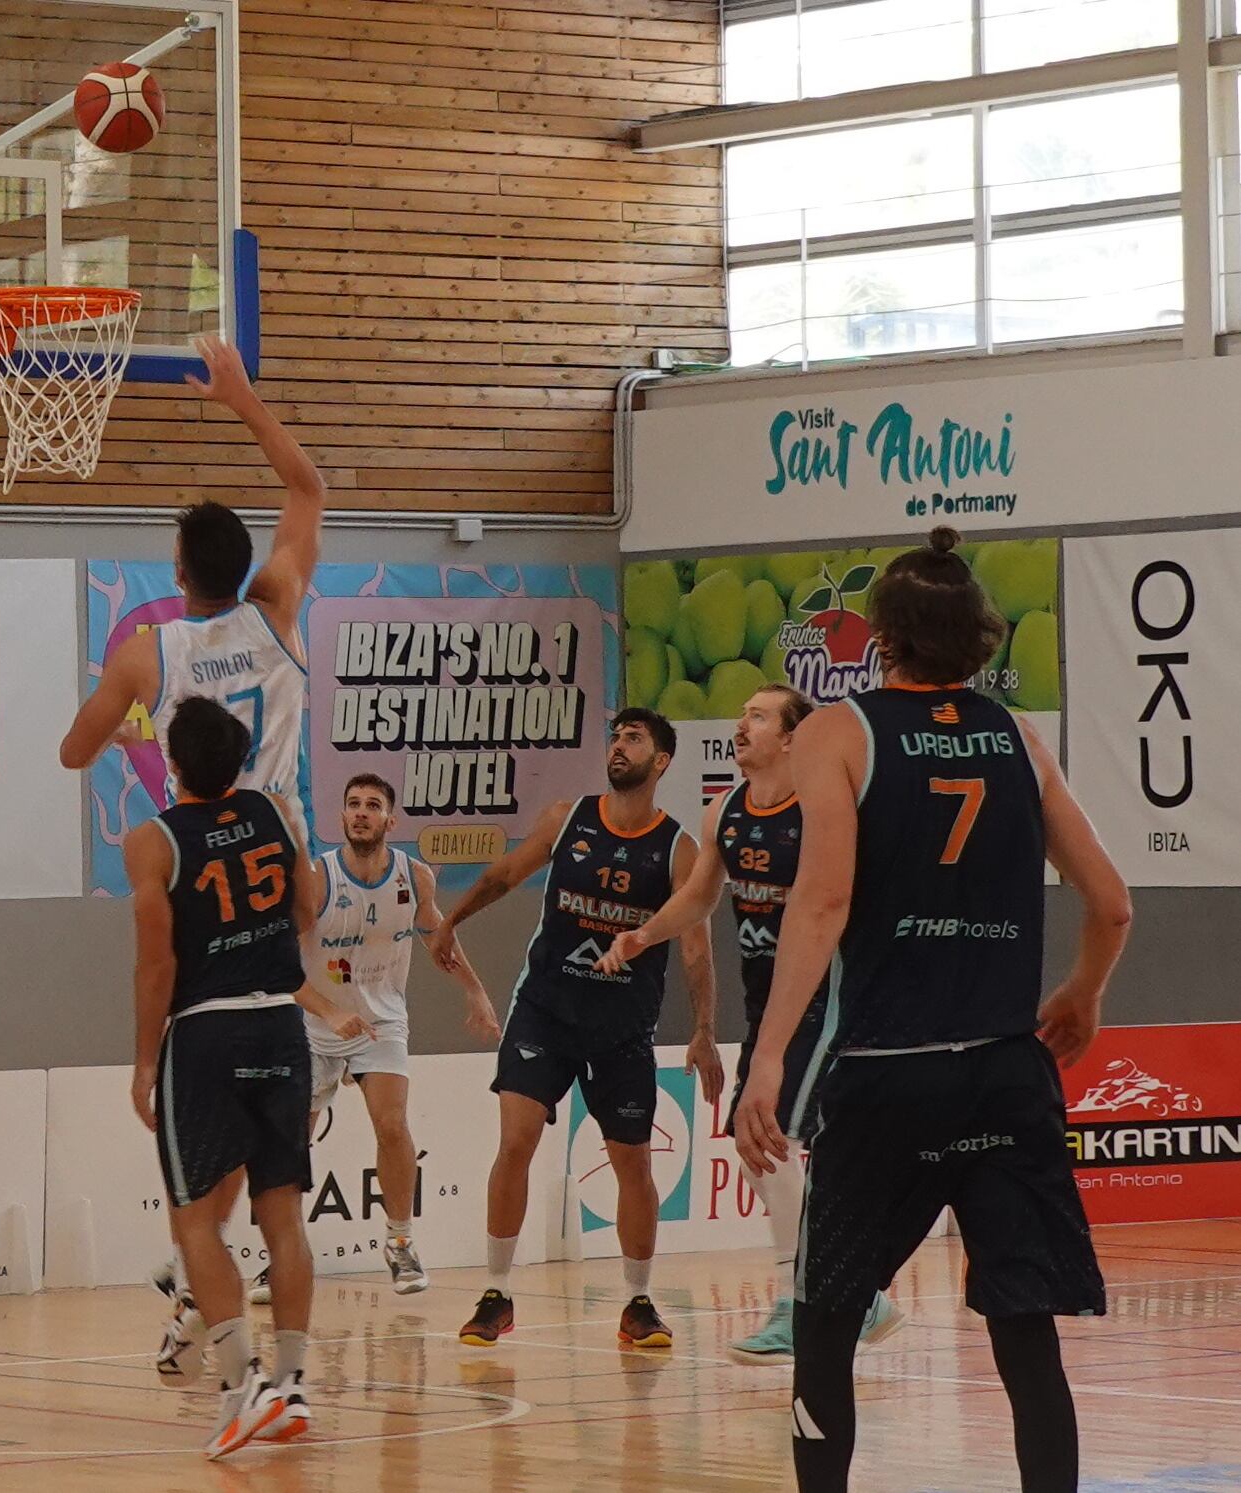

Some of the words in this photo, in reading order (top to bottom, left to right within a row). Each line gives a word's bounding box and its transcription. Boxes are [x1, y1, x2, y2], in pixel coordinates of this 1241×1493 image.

[798, 407, 835, 429] Visit
[765, 410, 858, 495] Sant
[866, 402, 1016, 488] Antoni
[906, 496, 927, 516] de
[932, 492, 1017, 516] Portmany
[778, 621, 827, 648] Frutas
[334, 621, 479, 685] IBIZA'S
[478, 621, 550, 685] NO.
[553, 621, 578, 684] 1
[788, 647, 883, 699] March
[981, 670, 997, 690] 19
[1001, 668, 1019, 689] 38
[1131, 560, 1195, 809] OKU
[330, 687, 585, 751] DESTINATION
[899, 731, 1014, 759] URBUTIS
[402, 752, 518, 816] HOTEL
[929, 777, 986, 865] 7
[431, 833, 496, 856] #DAYLIFE
[1148, 832, 1191, 852] IBIZA
[738, 847, 771, 873] 32
[194, 841, 286, 923] 15
[595, 867, 632, 894] 13
[365, 902, 377, 926] 4
[1109, 1172, 1183, 1188] Antonio
[142, 1199, 160, 1211] 19
[438, 1185, 459, 1197] 68
